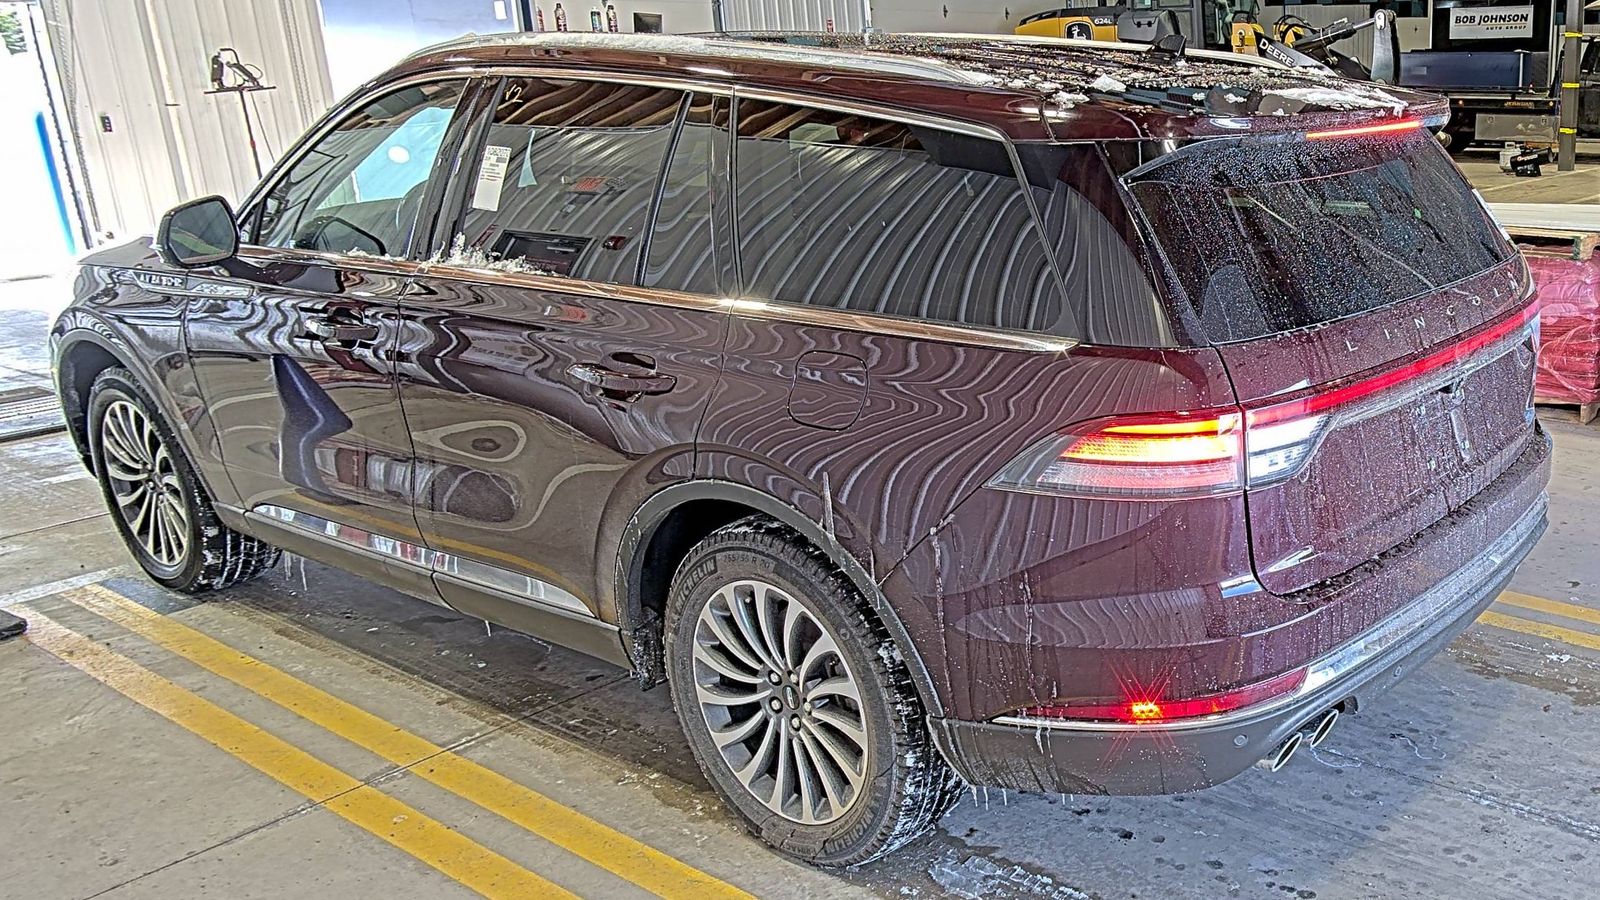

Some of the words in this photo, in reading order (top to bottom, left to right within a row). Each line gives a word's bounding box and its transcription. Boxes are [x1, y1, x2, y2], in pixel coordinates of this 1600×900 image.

[1455, 15, 1476, 24] BOB
[1478, 14, 1529, 25] JOHNSON
[1259, 38, 1294, 67] DEERE
[1345, 273, 1519, 352] LINCOLN
[675, 558, 716, 613] MICHELIN
[824, 807, 874, 854] MICHELIN
